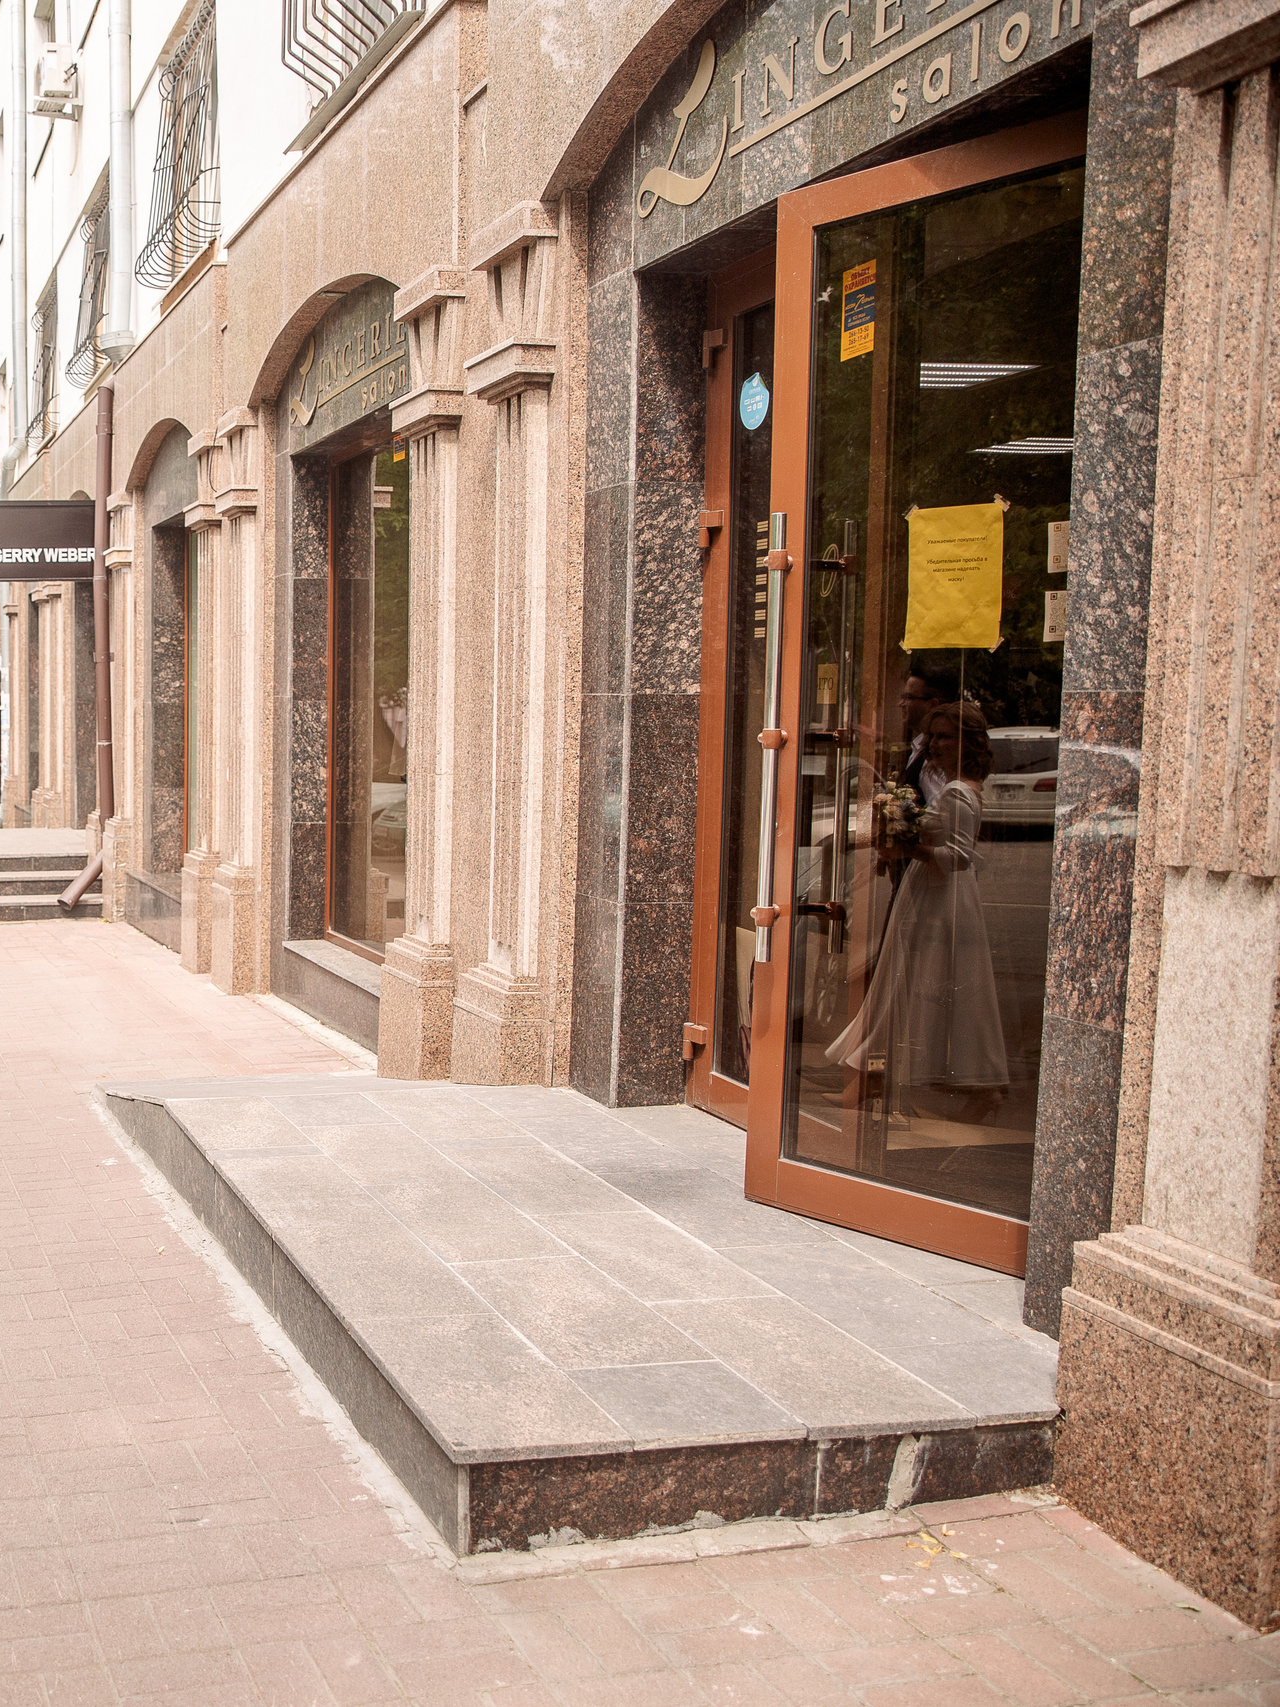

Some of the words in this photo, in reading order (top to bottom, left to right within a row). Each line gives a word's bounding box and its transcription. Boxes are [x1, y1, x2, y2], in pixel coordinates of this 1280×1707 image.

[290, 312, 406, 426] LINGERIE
[362, 364, 406, 409] salon
[43, 547, 95, 563] WEBER
